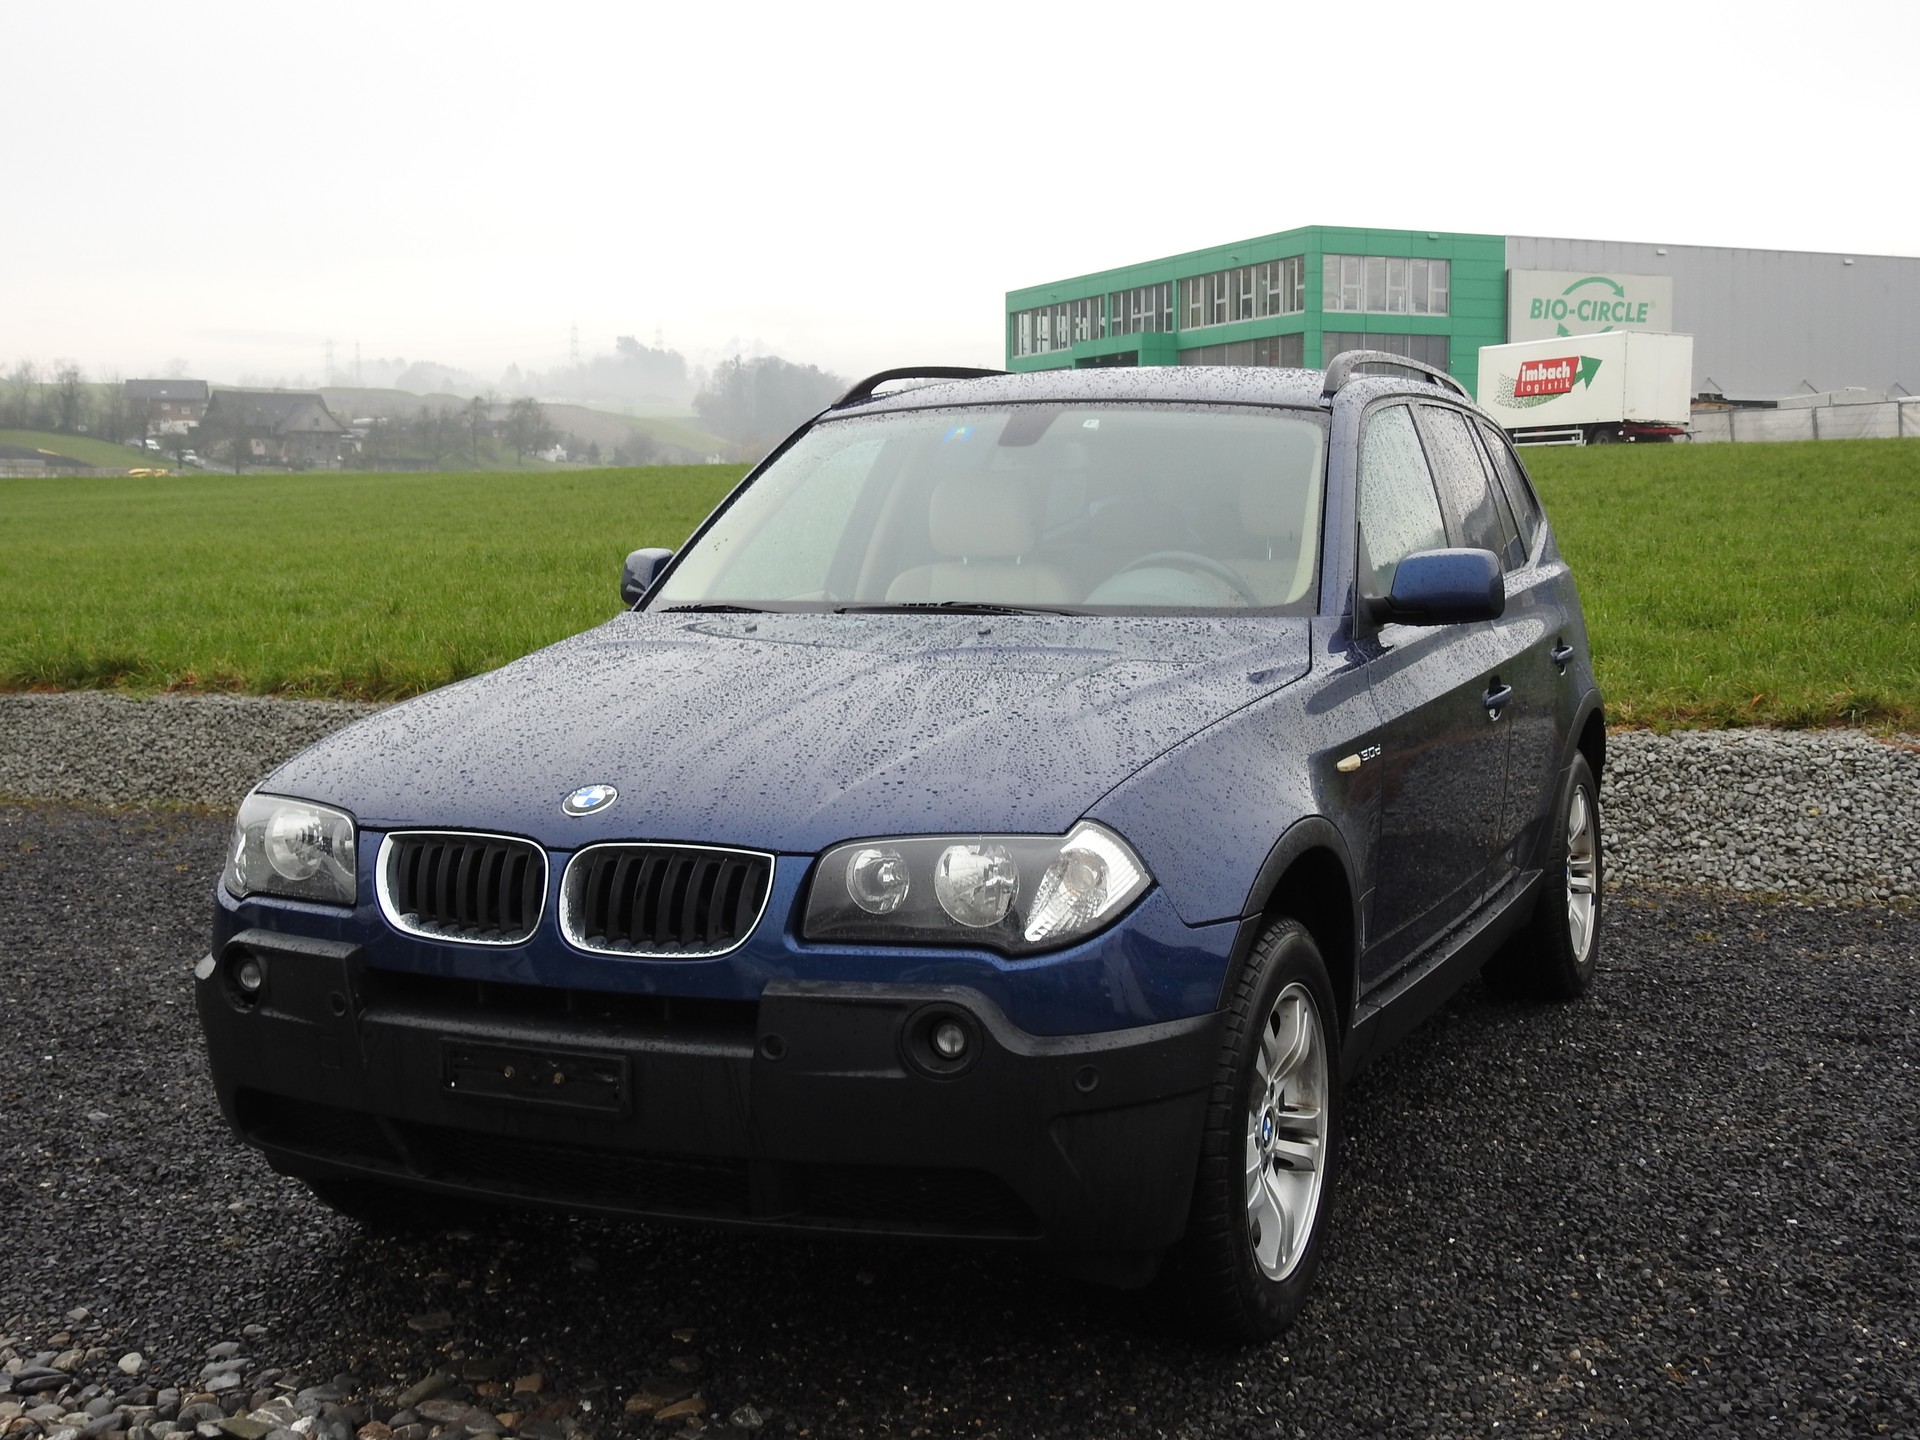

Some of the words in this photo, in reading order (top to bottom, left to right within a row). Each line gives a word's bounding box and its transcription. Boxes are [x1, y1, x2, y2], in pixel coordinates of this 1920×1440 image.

[1530, 298, 1649, 323] BIO-CIRCLE
[1521, 361, 1570, 382] imbach
[1520, 378, 1570, 394] logistik
